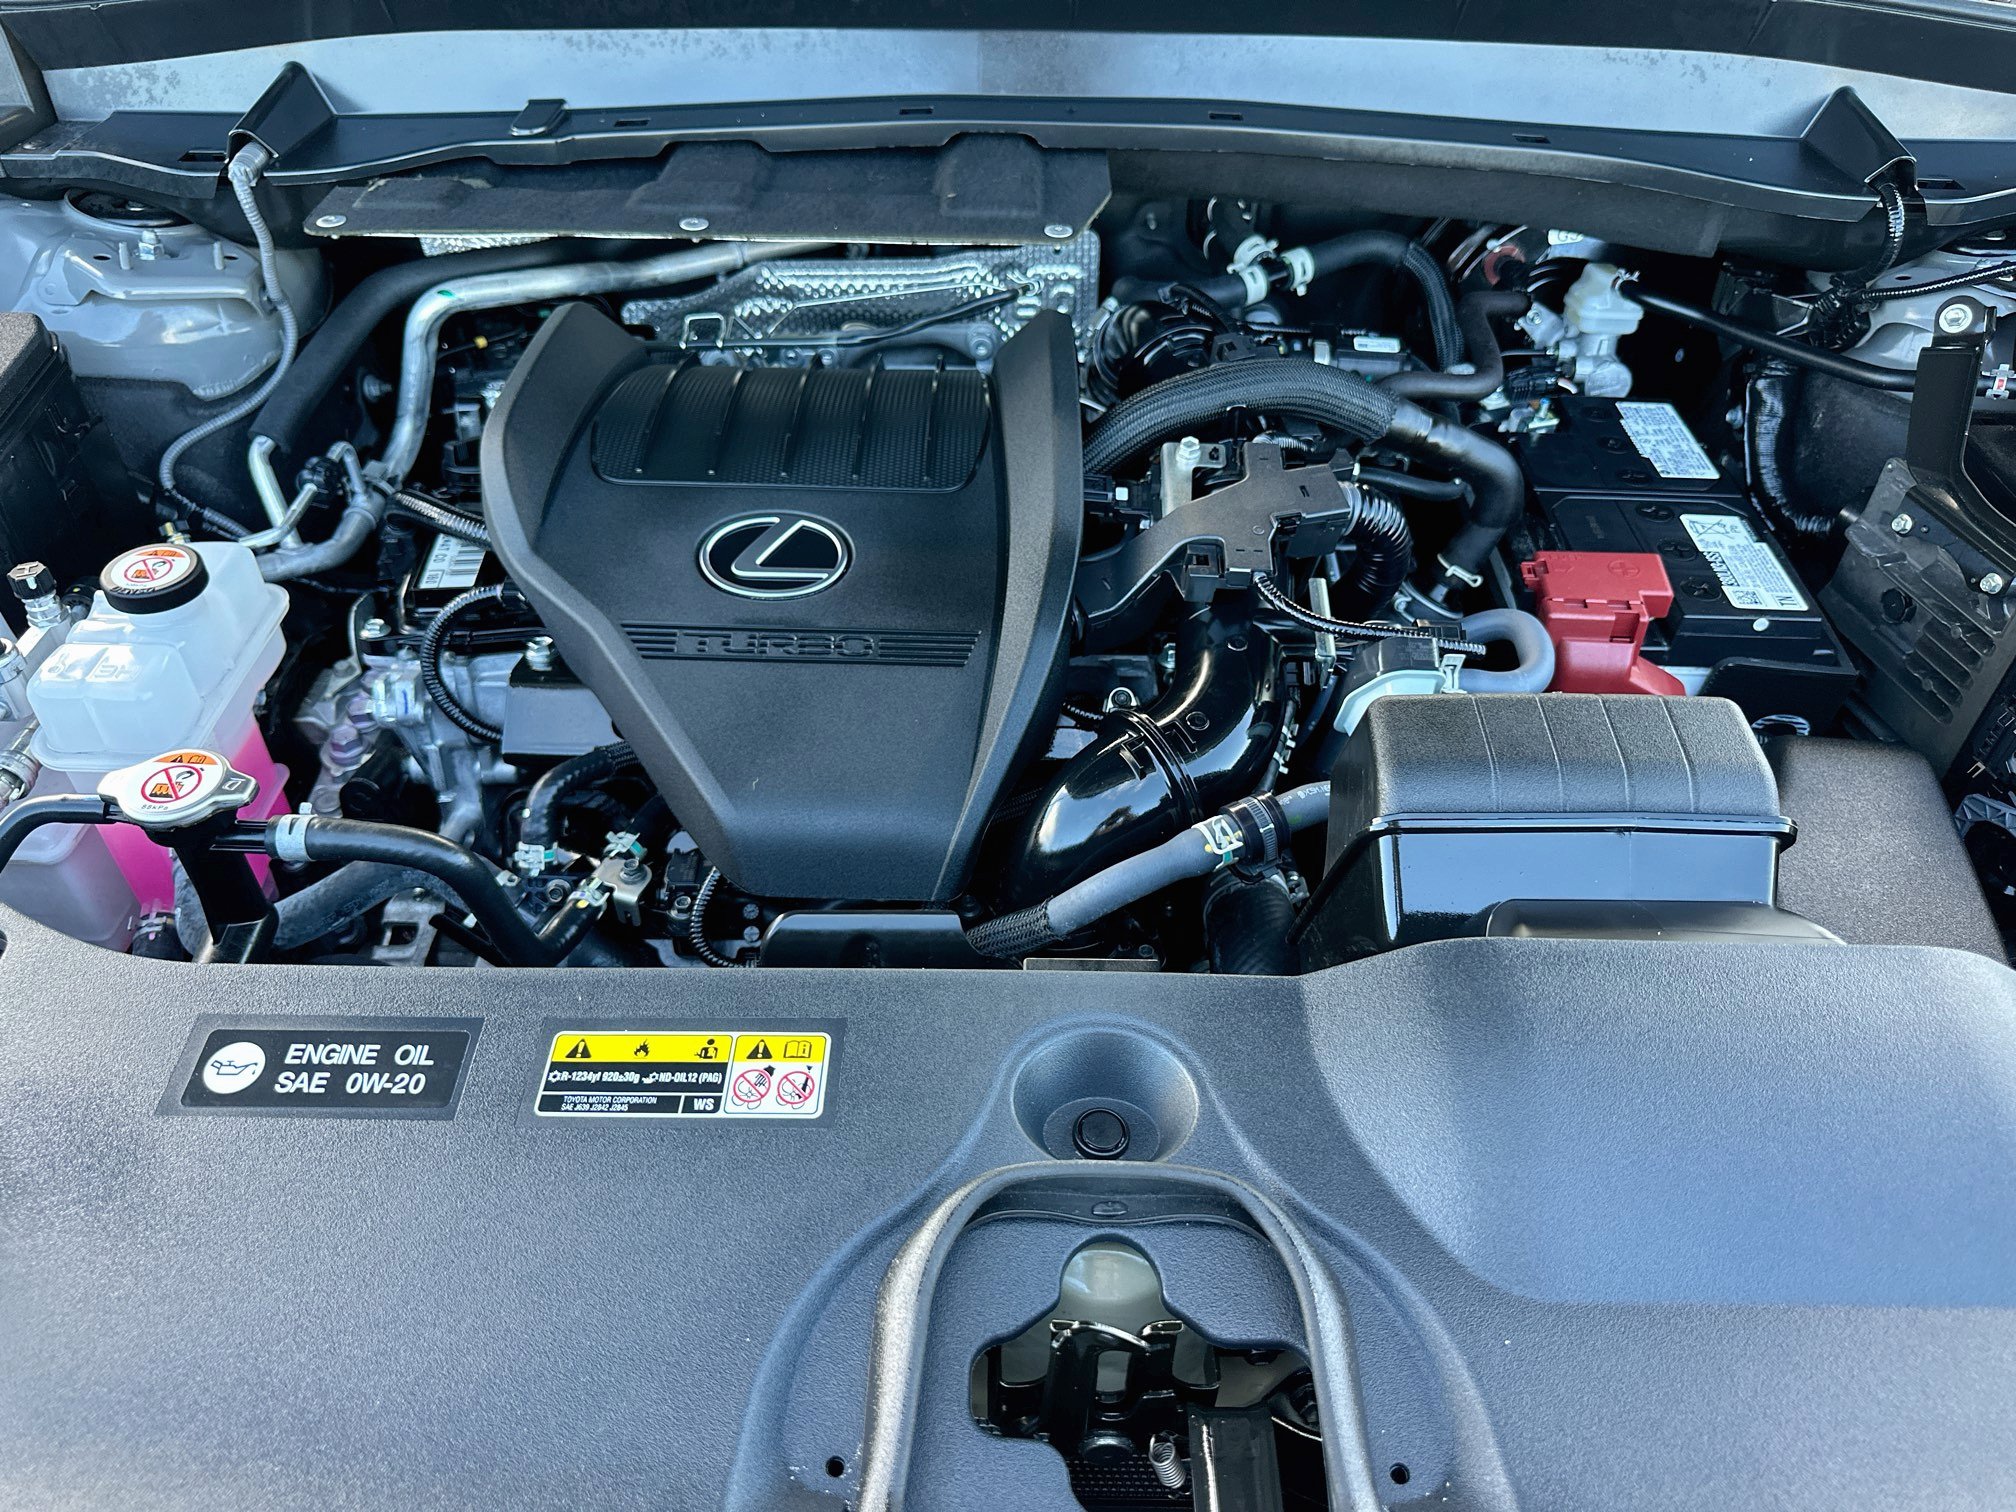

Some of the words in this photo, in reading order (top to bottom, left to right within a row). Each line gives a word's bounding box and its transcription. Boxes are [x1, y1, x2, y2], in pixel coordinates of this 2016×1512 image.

[683, 631, 874, 657] TURBO
[284, 1043, 381, 1065] ENGINE
[394, 1044, 434, 1066] OIL
[274, 1072, 331, 1094] SAE
[345, 1073, 426, 1095] 0W-20
[560, 1071, 600, 1084] R-1234yf
[698, 1072, 722, 1084] (PAG)
[563, 1096, 588, 1104] TOYOTA
[589, 1096, 612, 1104] MOTOR
[693, 1098, 715, 1111] WS
